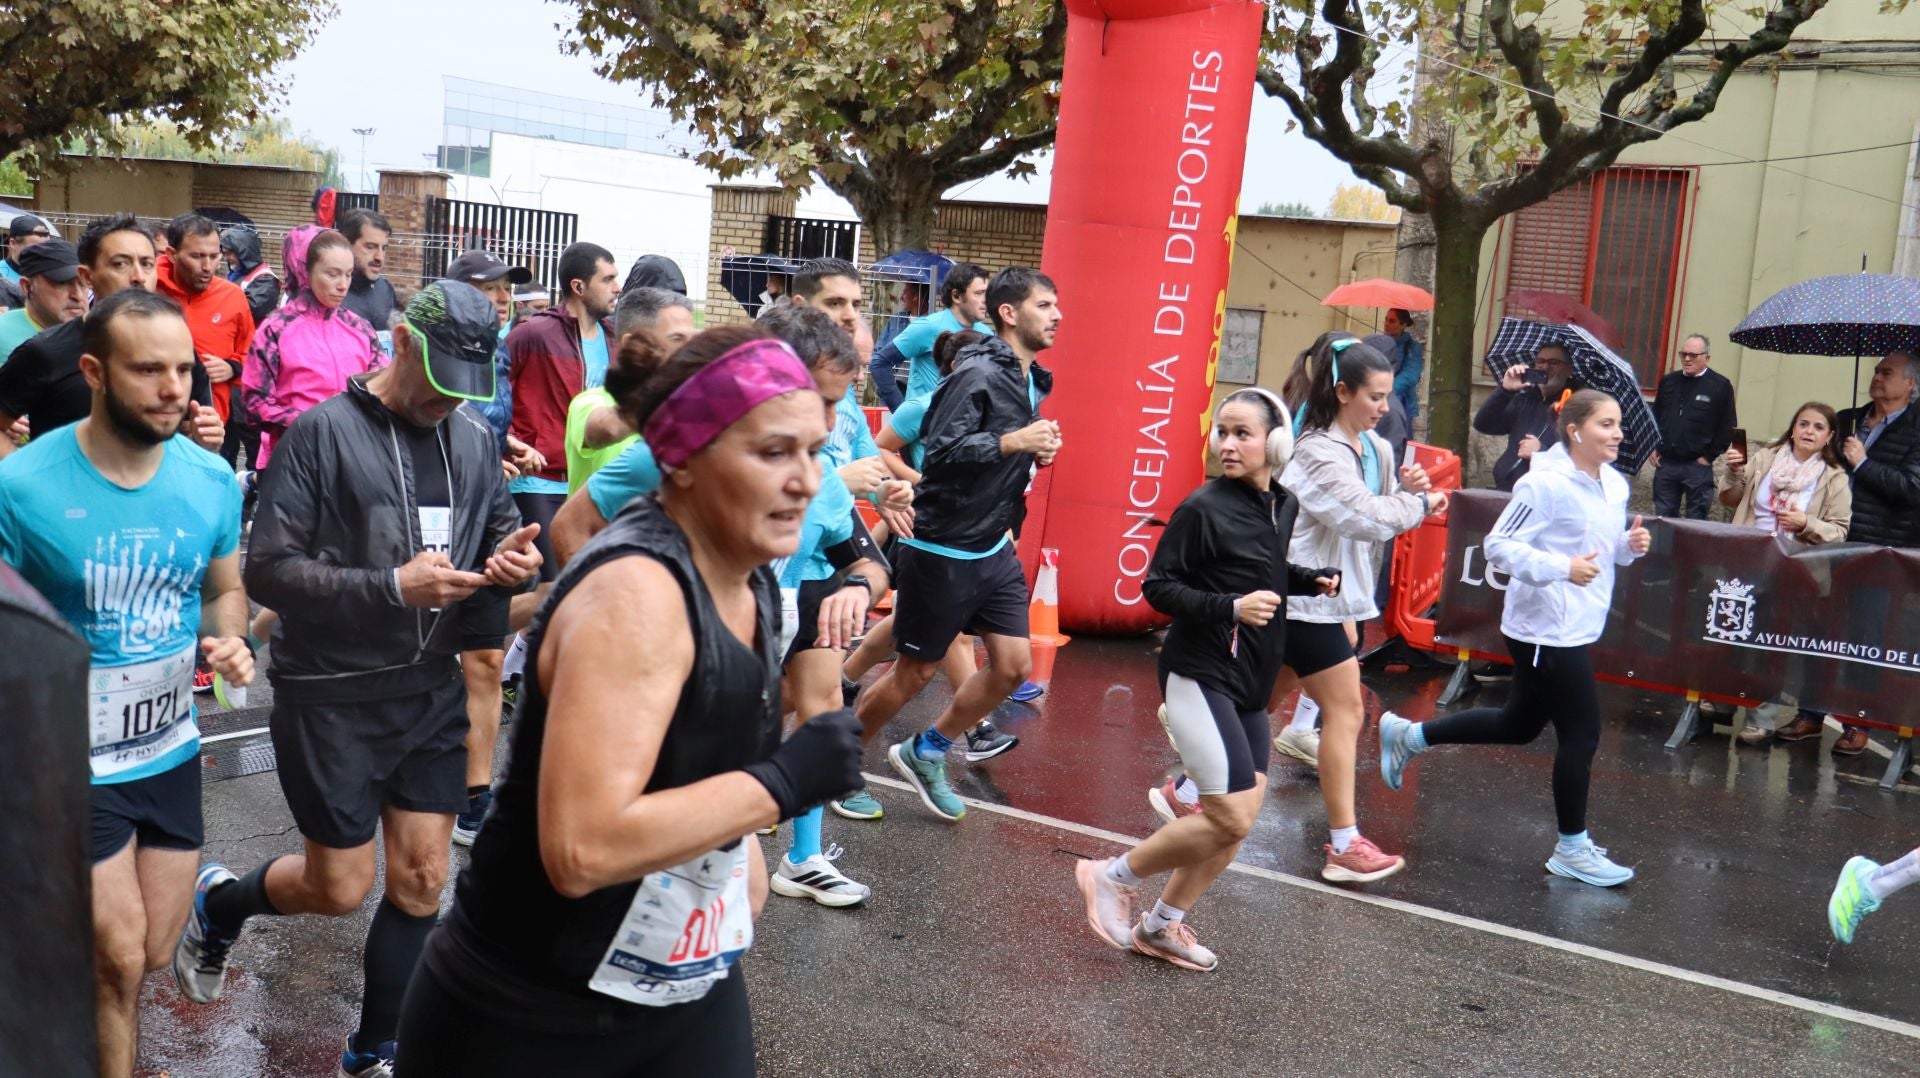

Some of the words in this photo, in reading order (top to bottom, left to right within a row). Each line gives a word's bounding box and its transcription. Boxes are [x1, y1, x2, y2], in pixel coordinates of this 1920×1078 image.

[1164, 50, 1223, 265] DEPORTES
[1152, 282, 1190, 336] DE
[1114, 354, 1180, 606] CONCEJALÍA
[1755, 632, 1881, 660] AYUNTAMIENTO
[1885, 650, 1907, 665] DE
[122, 686, 178, 740] 1021
